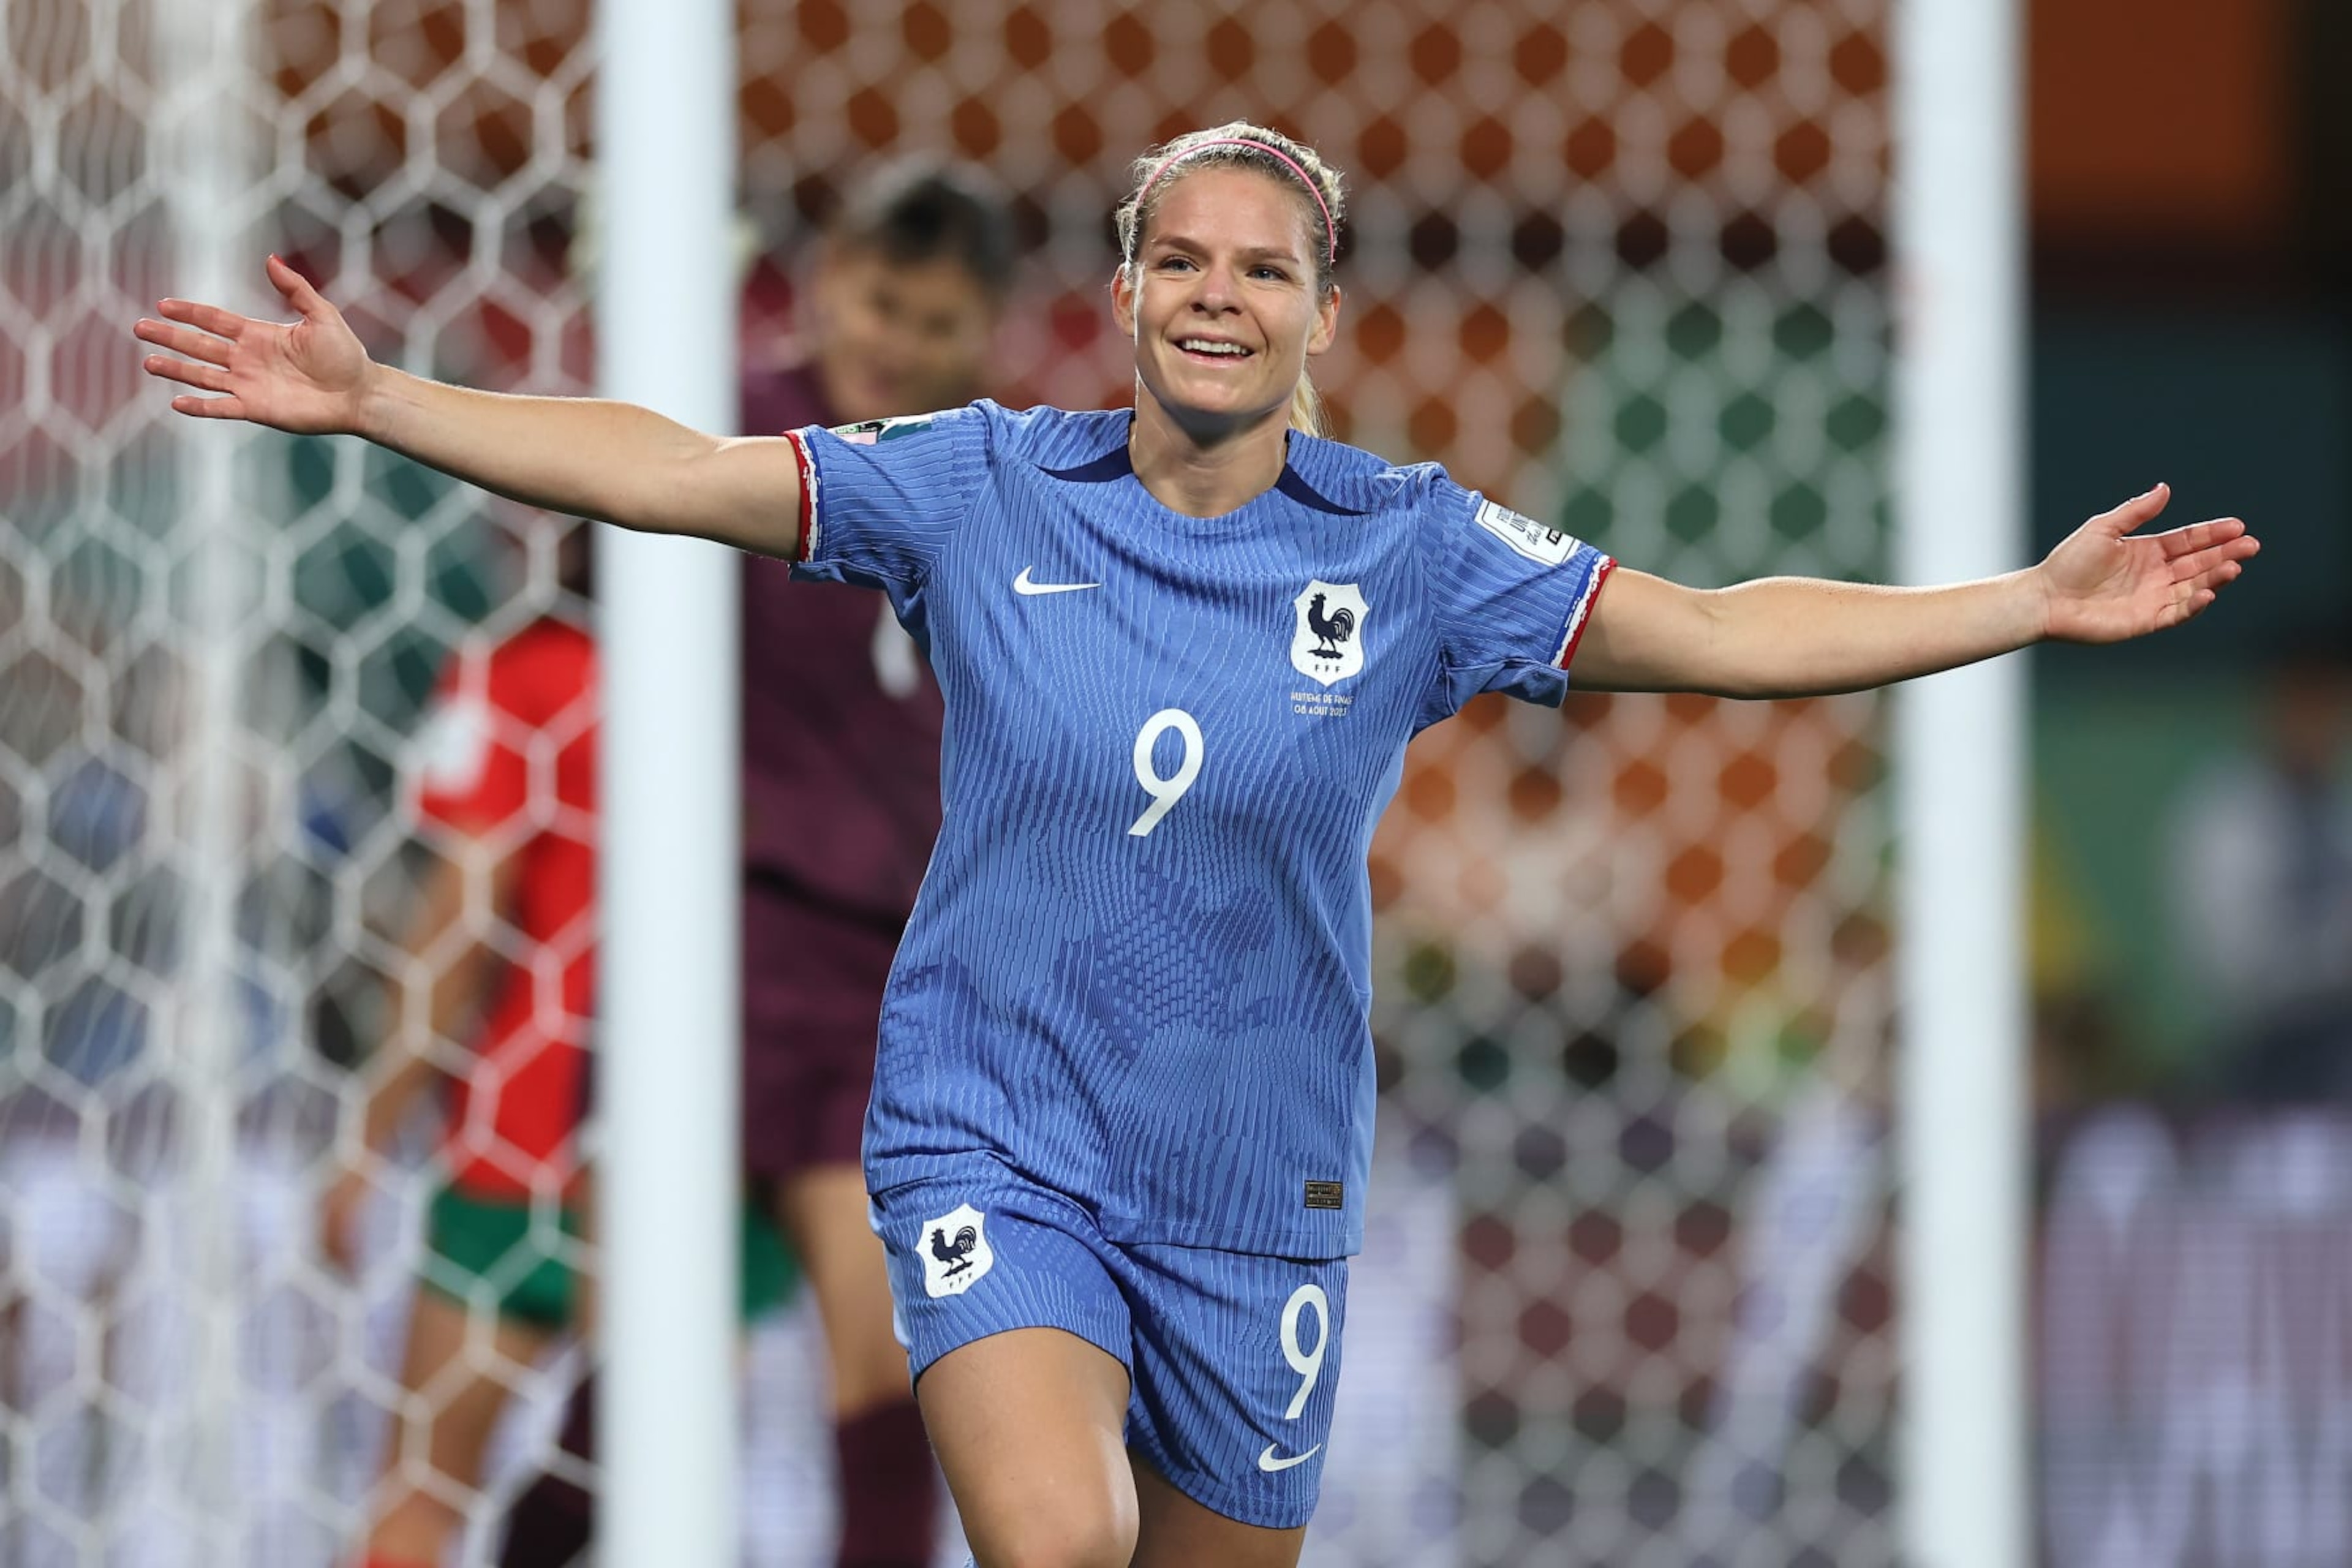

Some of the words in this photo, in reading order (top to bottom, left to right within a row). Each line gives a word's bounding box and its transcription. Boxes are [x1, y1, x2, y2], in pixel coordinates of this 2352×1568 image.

[1323, 693, 1333, 704] DE
[1128, 708, 1204, 837] 9
[1280, 1284, 1329, 1419] 9
